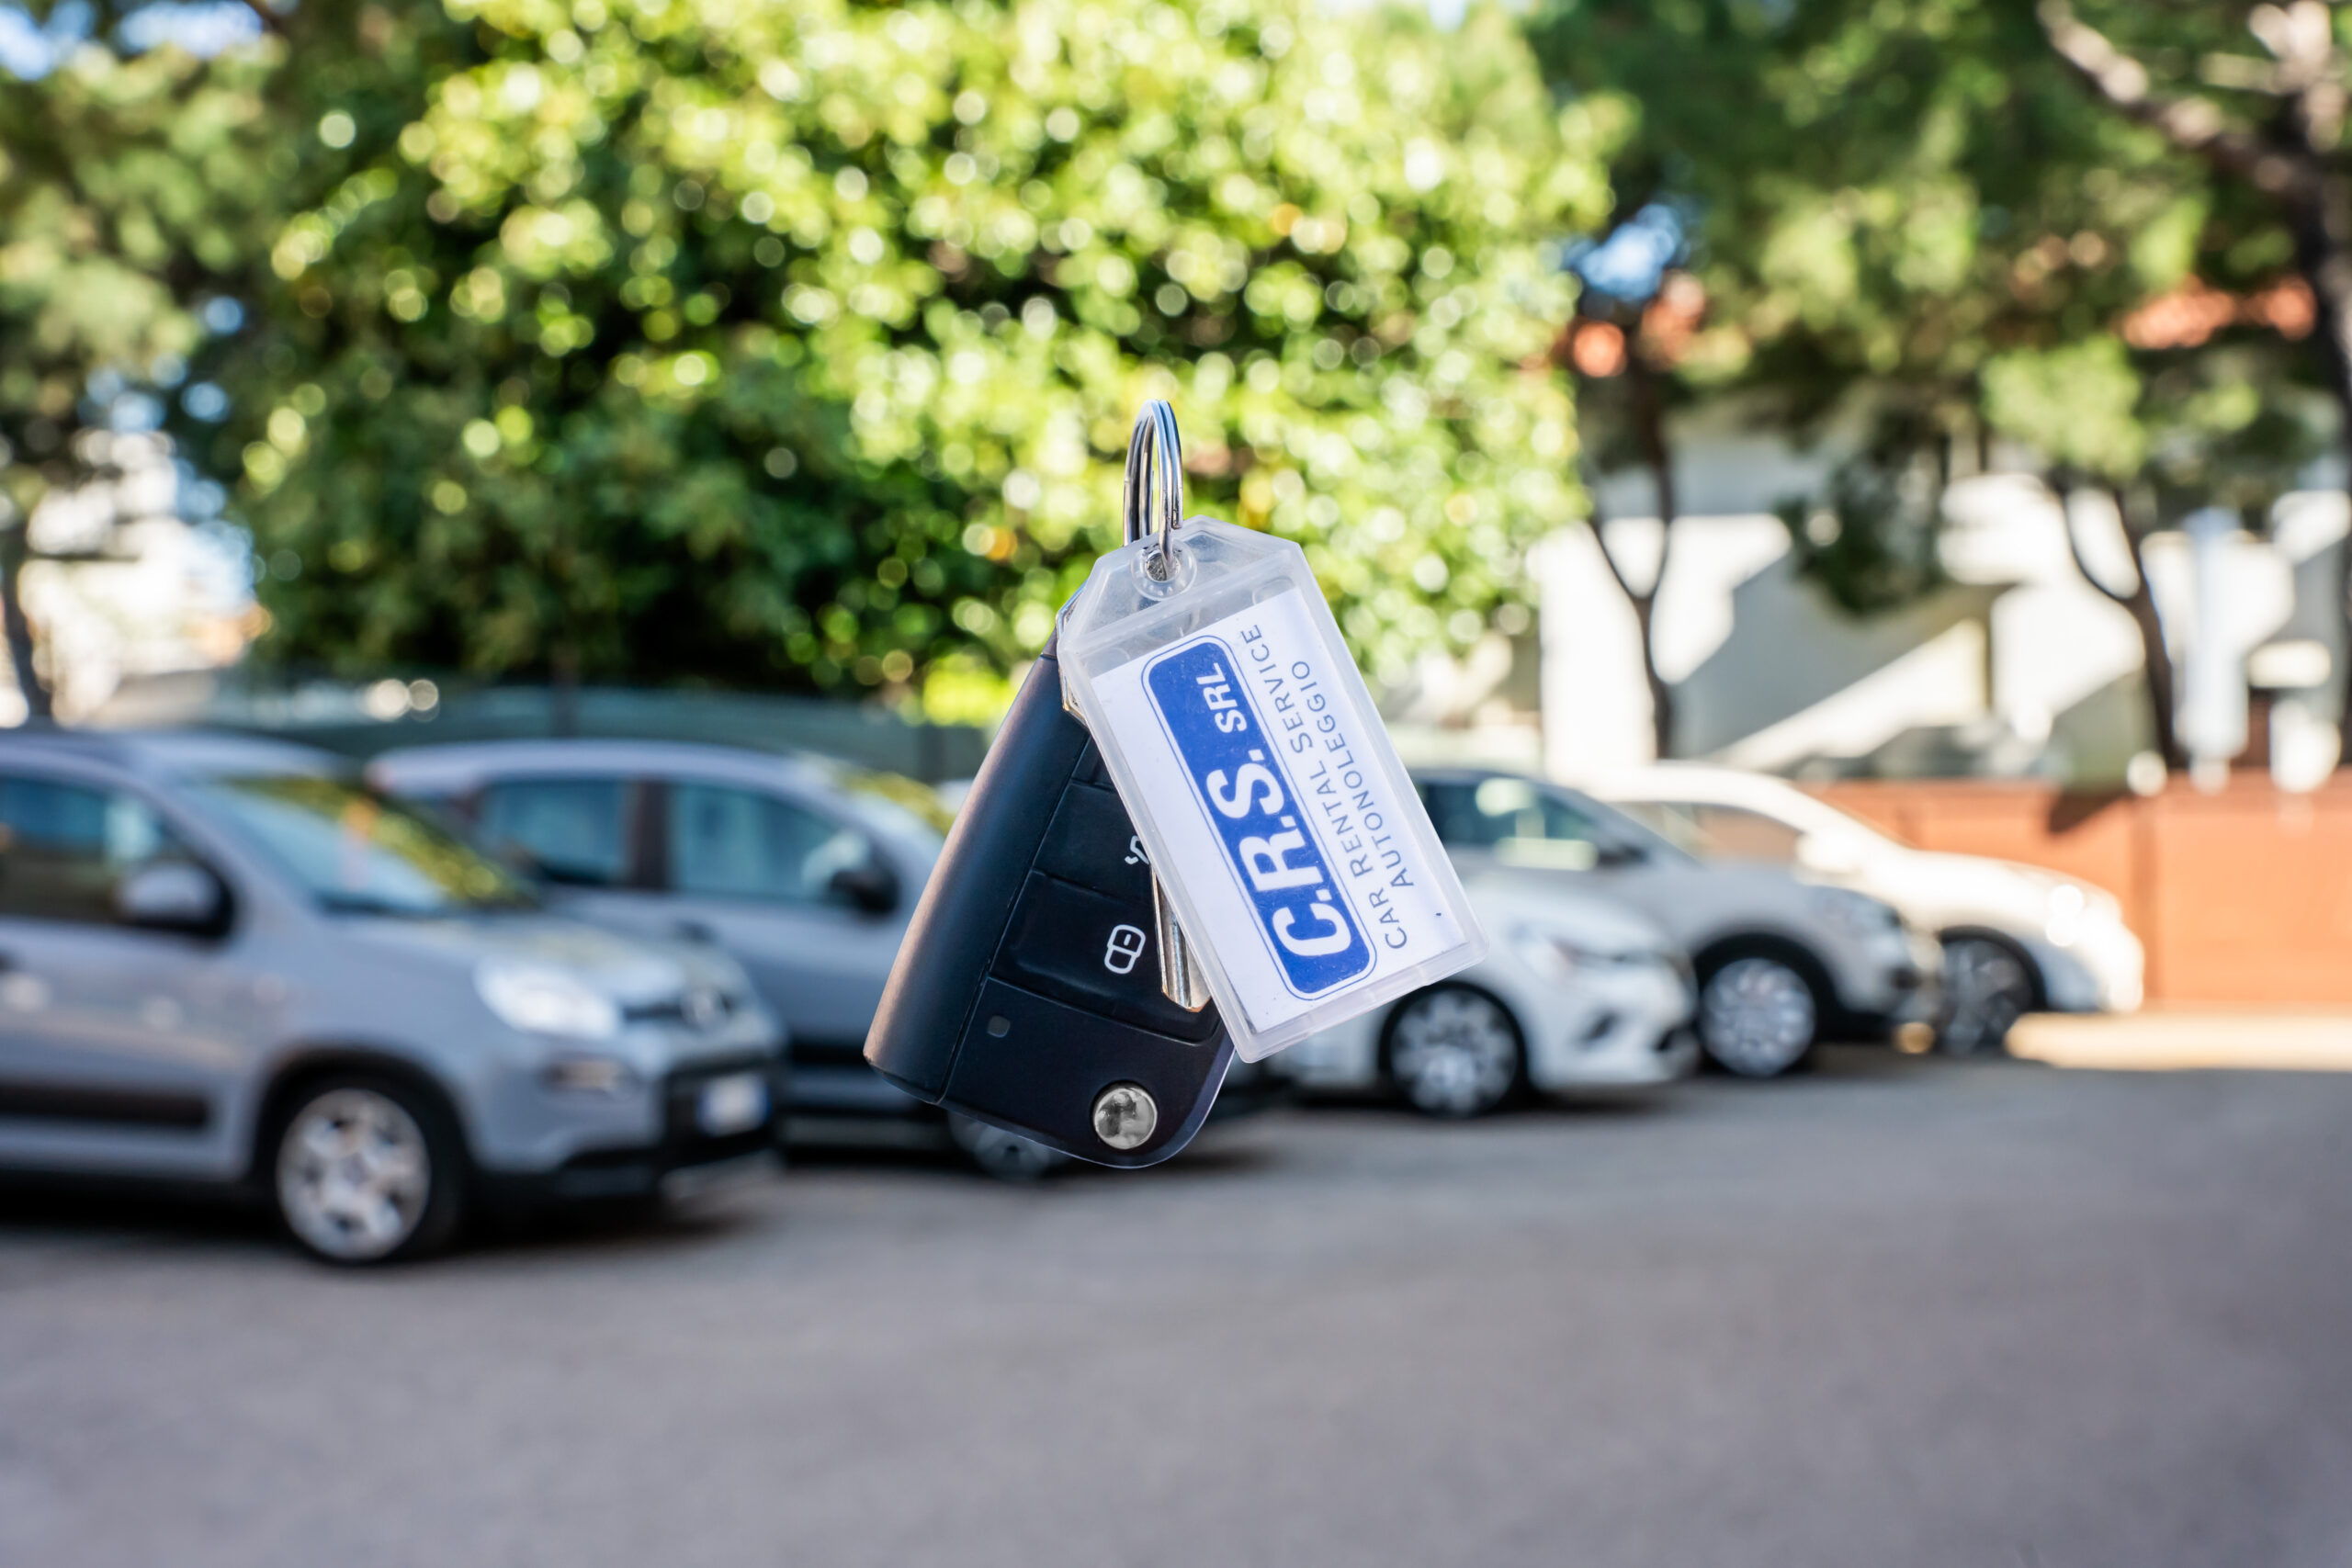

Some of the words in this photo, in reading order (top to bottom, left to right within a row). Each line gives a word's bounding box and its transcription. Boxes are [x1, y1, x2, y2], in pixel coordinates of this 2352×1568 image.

[1195, 662, 1248, 734] SRL
[1240, 624, 1313, 754] SERVICE
[1291, 660, 1415, 888] AUTONOLEGGIO
[1309, 760, 1374, 878] RENTAL
[1206, 748, 1352, 957] C.R.S.
[1369, 886, 1408, 950] CAR
